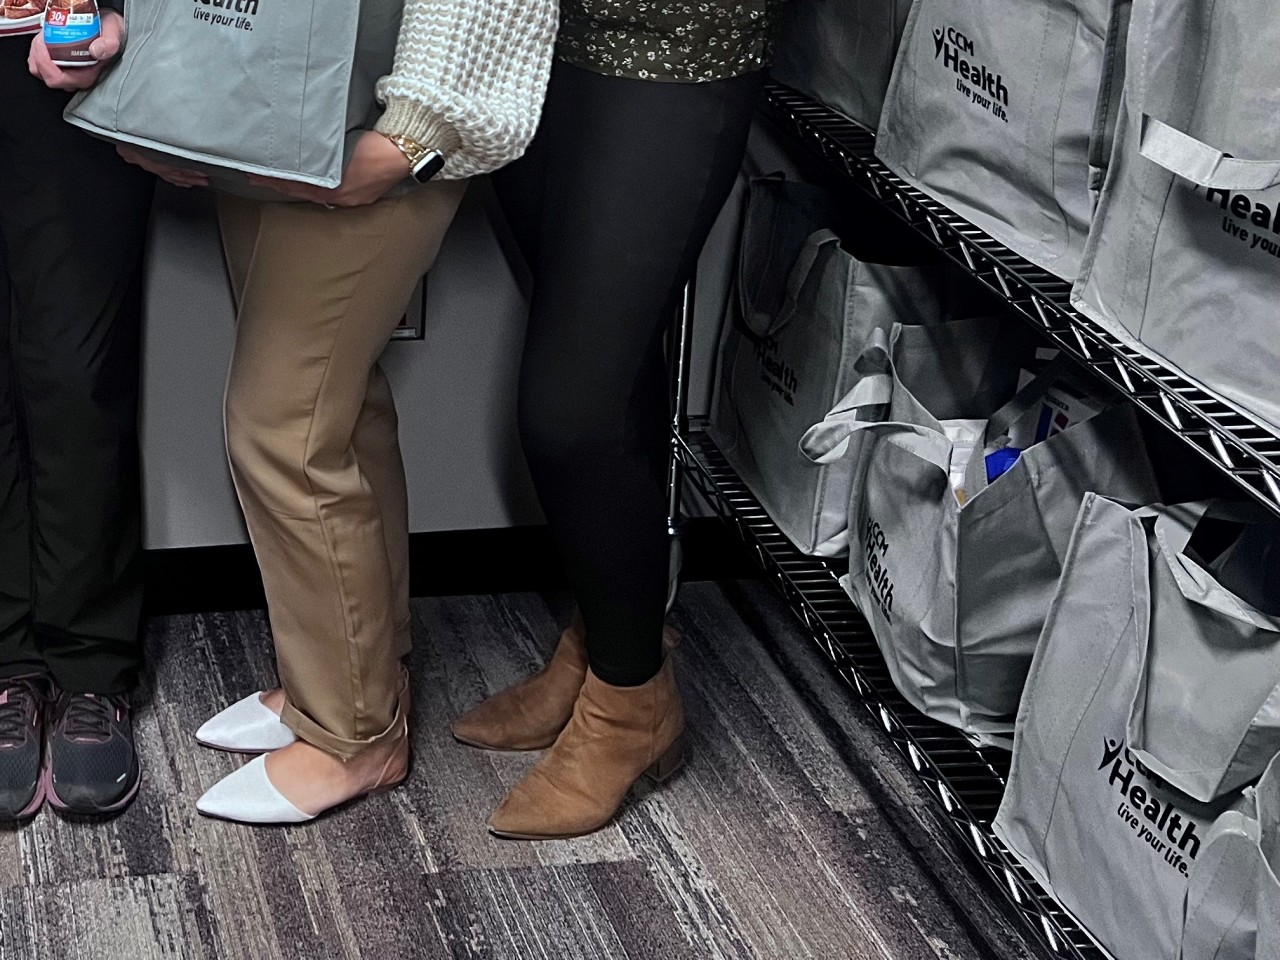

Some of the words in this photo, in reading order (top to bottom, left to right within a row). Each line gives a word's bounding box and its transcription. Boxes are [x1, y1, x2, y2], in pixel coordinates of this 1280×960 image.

[49, 10, 66, 22] 30g
[193, 6, 210, 21] live
[210, 12, 234, 25] your
[234, 15, 254, 31] life.
[947, 27, 974, 57] CCM
[943, 42, 1009, 107] Health
[956, 78, 971, 98] live
[971, 91, 991, 110] your
[992, 101, 1009, 123] life.
[1222, 216, 1249, 241] live
[756, 346, 798, 394] Health
[865, 532, 894, 613] Health
[1108, 757, 1201, 860] Health
[1117, 802, 1139, 829] live
[1137, 824, 1166, 853] your
[1164, 847, 1189, 879] life.
